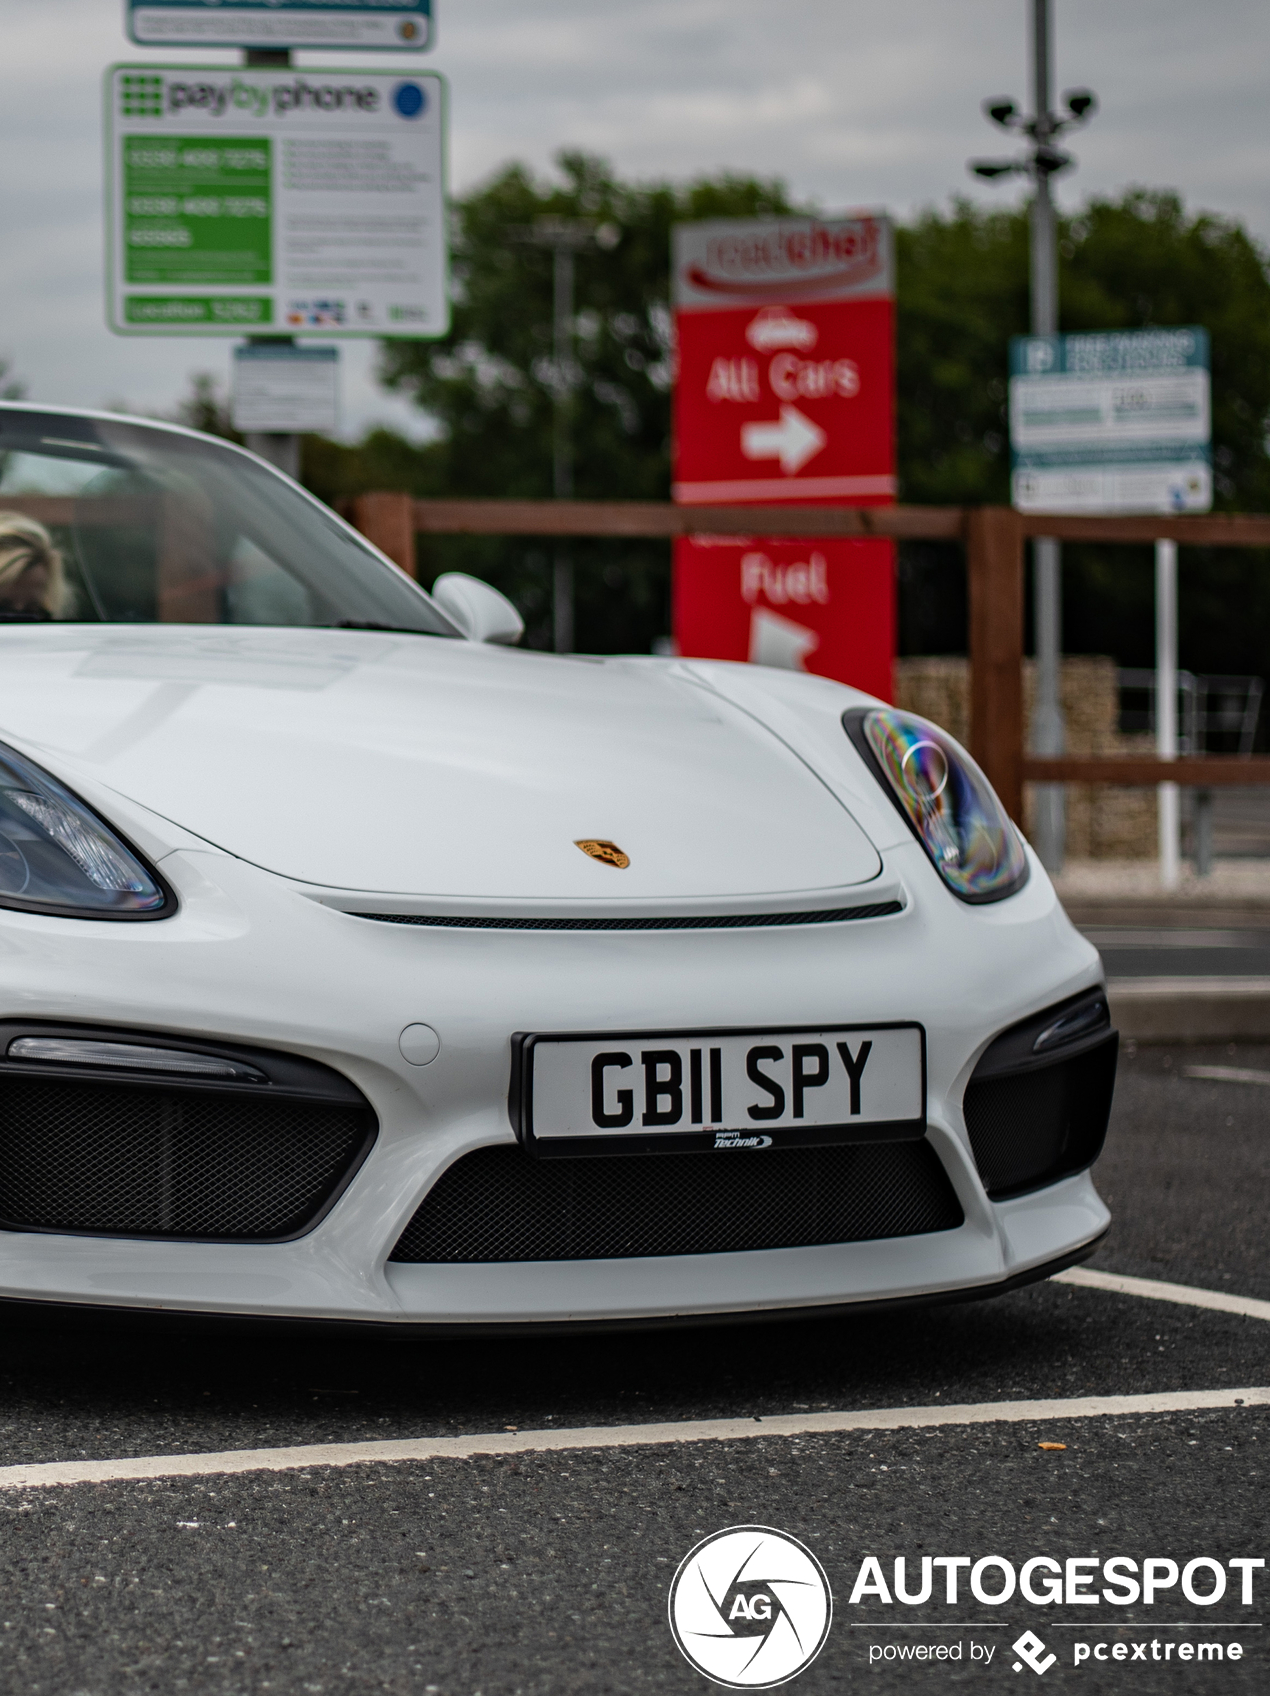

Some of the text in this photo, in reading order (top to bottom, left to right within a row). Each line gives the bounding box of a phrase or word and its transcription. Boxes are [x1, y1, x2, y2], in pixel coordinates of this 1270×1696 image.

[168, 76, 380, 117] paybyphone
[706, 352, 860, 402] All Cars
[740, 551, 829, 604] Fuel
[590, 1040, 872, 1128] GB11 SPY
[713, 1136, 761, 1148] Technik
